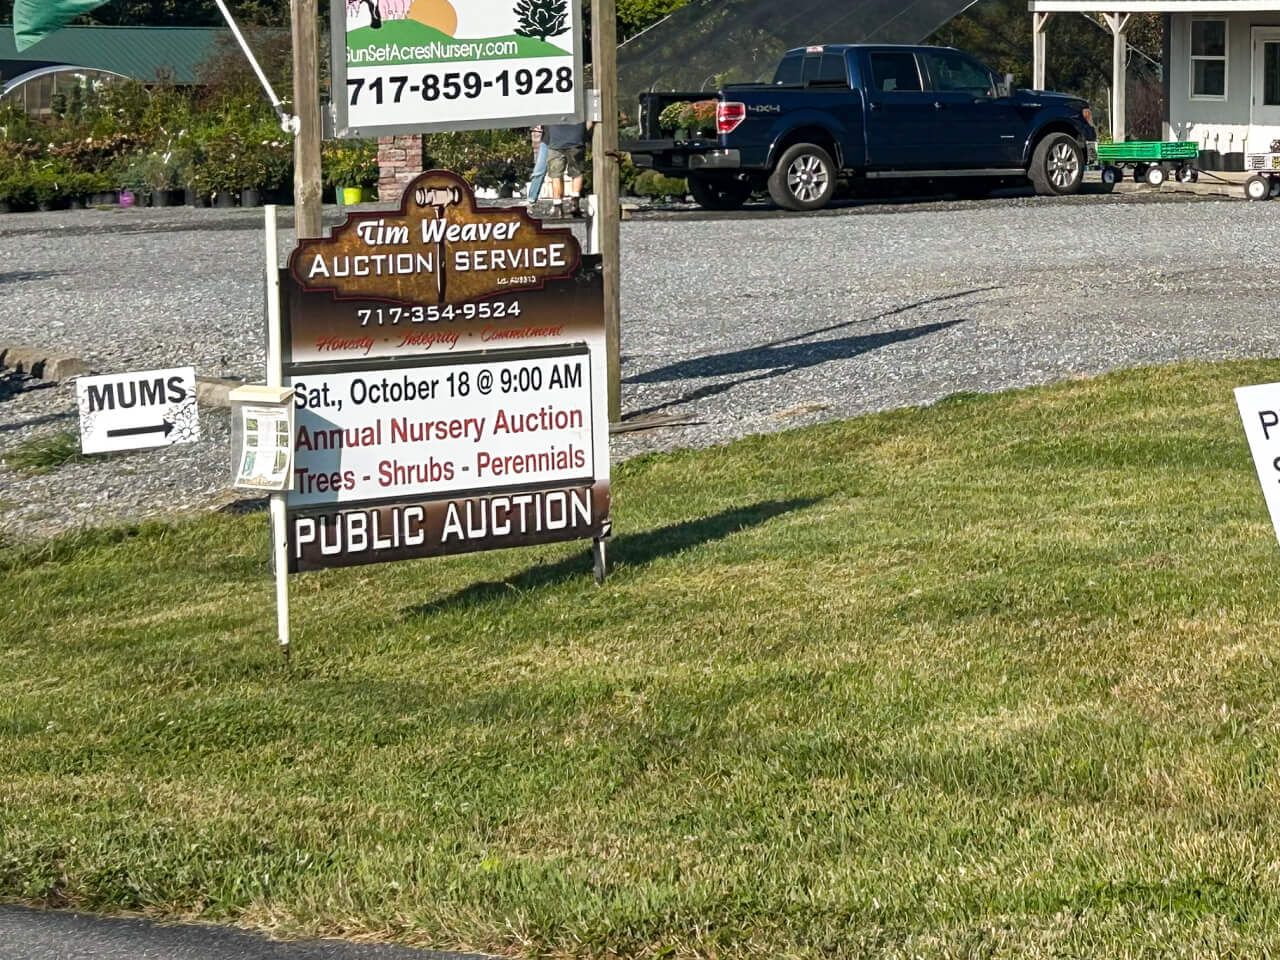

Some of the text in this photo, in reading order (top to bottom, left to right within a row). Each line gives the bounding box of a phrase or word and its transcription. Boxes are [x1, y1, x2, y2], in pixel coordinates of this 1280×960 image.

[346, 66, 573, 106] 717-859-1928
[357, 219, 521, 246] Tim Weaver
[308, 243, 566, 279] AUCTION SERVICE
[357, 300, 521, 327] 717-354-9524
[316, 323, 566, 356] Honesty Integrity Commitment
[87, 375, 188, 413] MUMS
[294, 381, 343, 412] Sat.,
[350, 375, 440, 405] October
[446, 371, 470, 398] 18
[476, 369, 494, 396] @
[500, 366, 543, 394] 9:00
[549, 362, 583, 390] AM
[295, 418, 381, 453] Annual
[391, 416, 486, 443] Nursery
[493, 404, 584, 436] Auction
[294, 467, 356, 495] Trees
[378, 456, 455, 488] Shrubs
[477, 443, 586, 478] Perennials
[295, 487, 592, 559] PUBLIC AUCTION
